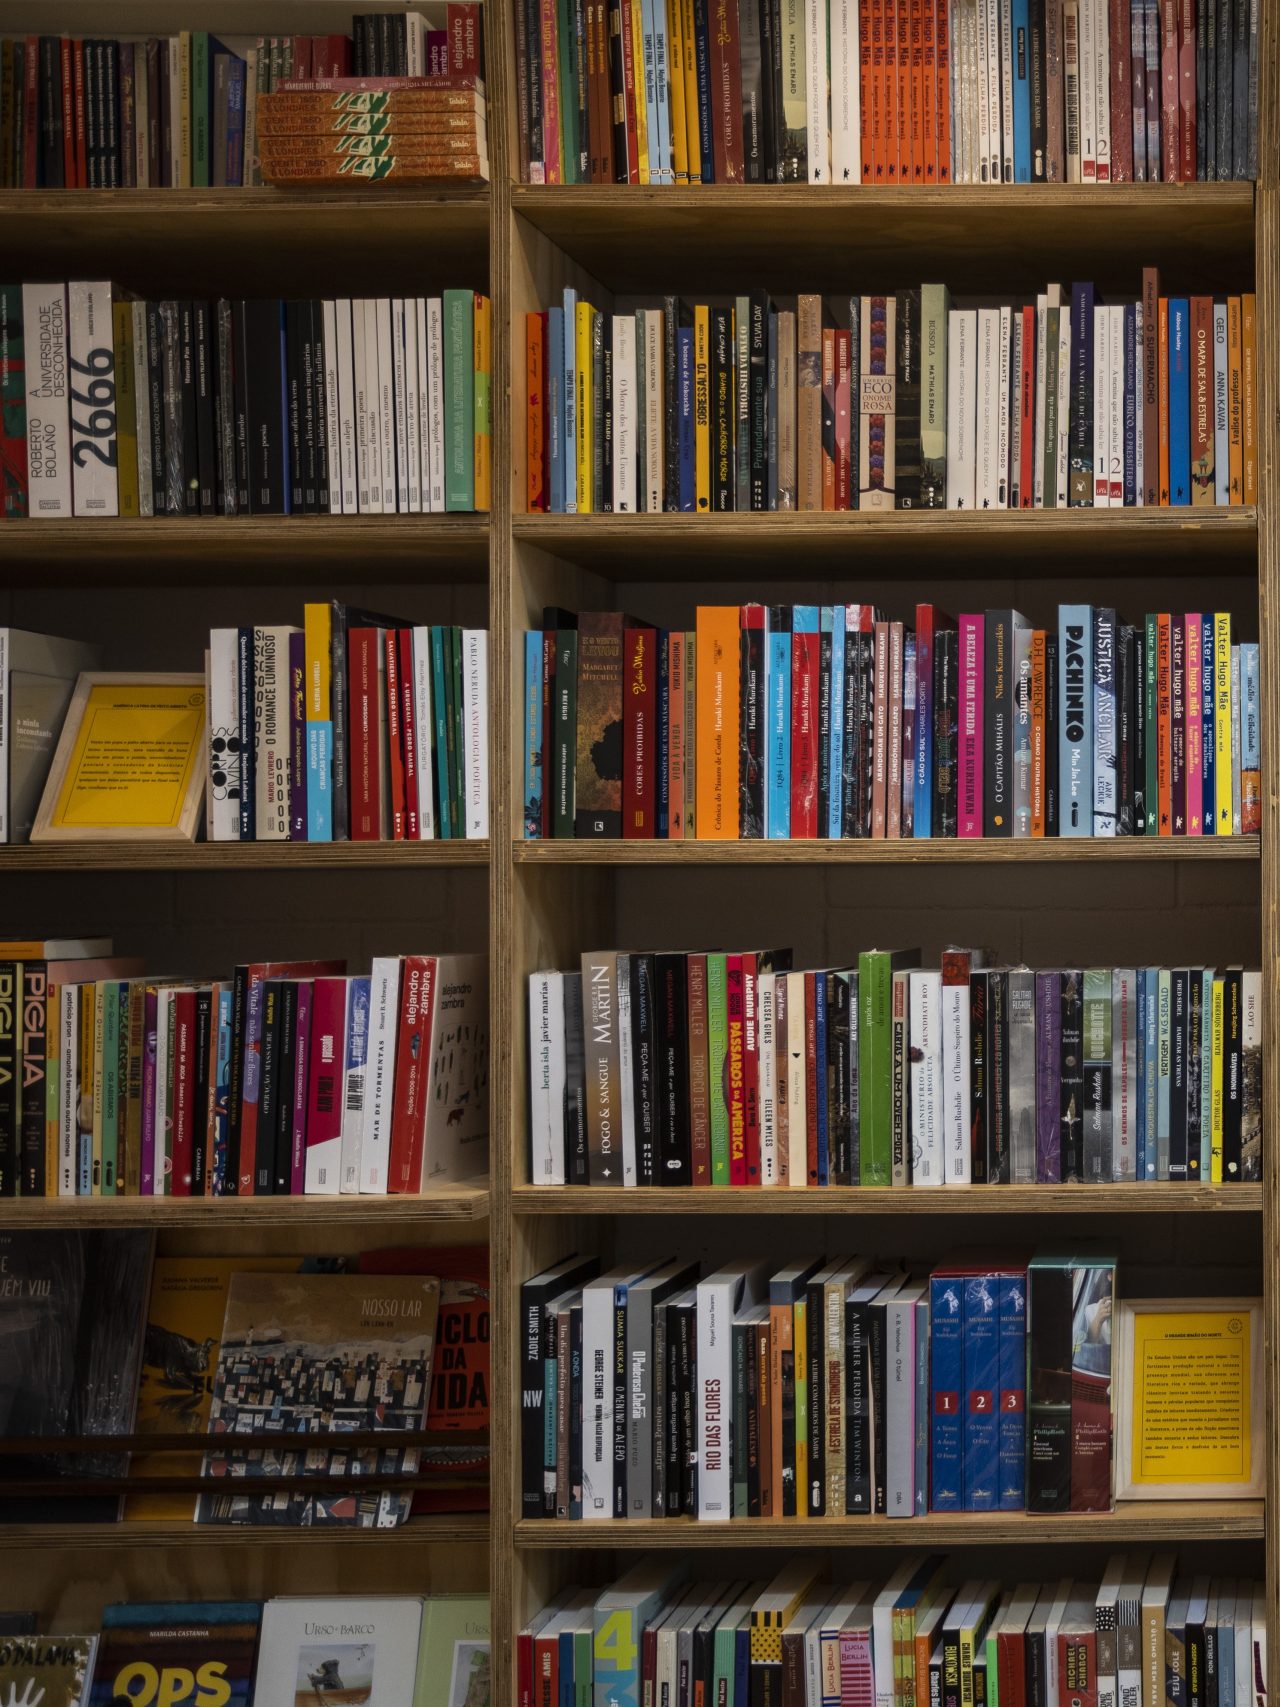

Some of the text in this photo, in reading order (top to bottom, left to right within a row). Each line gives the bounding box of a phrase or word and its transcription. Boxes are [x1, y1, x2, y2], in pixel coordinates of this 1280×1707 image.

[454, 18, 462, 70] alejandro
[466, 19, 474, 60] zambra
[698, 36, 706, 76] MÁSCARA
[702, 95, 707, 103] DE
[723, 63, 731, 113] PROIBIDAS
[701, 105, 709, 153] CONFISSÕES
[751, 147, 757, 157] Os
[41, 305, 53, 398] UNIVERSIDADE
[52, 299, 64, 397] DESCONHECIDA
[754, 306, 762, 348] SYLVIA DAY
[1216, 318, 1224, 343] GELO
[29, 388, 40, 398] A
[697, 364, 707, 425] SOBRESSALTO
[1147, 337, 1155, 404] SUPERMACHO
[1231, 370, 1240, 405] professor
[70, 348, 117, 468] 2666
[753, 396, 763, 469] Profundamente
[1217, 400, 1225, 430] KAVAN
[1231, 407, 1238, 415] do
[1231, 417, 1239, 436] valise
[30, 419, 43, 477] ROBERTO
[42, 424, 57, 477] BOLAÑO
[265, 635, 275, 684] LUMINOSO
[995, 624, 1003, 699] Nikos Kazantzákis
[1066, 626, 1083, 742] PACHINKO
[265, 688, 275, 735] ROMANCE
[714, 672, 722, 730] Haruki Murakami
[212, 727, 227, 800] CORPOS
[227, 727, 239, 799] DIVINOS
[406, 971, 420, 1024] alejandro
[419, 972, 430, 1014] zambra
[591, 965, 611, 1044] MARTIN
[745, 975, 754, 1051] AUDIE MURPHY
[23, 973, 45, 1087] PIGLIA
[540, 982, 550, 1089] berta isla javier marías
[376, 1040, 384, 1098] TORMENTAS
[374, 1103, 380, 1115] DE
[599, 1057, 611, 1154] FOGO & SANGUE
[954, 1092, 962, 1121] Rushdie
[362, 1299, 422, 1317] NOSSO LAR
[529, 1306, 539, 1360] ZADIE SMITH
[523, 1390, 542, 1407] NW
[977, 1396, 984, 1408] 2
[1008, 1396, 1016, 1407] 3
[706, 1380, 720, 1470] RIO DAS FLORES
[594, 1609, 637, 1669] 4
[842, 1652, 868, 1661] BERLIN
[1067, 1646, 1075, 1688] MICHAEL
[1079, 1647, 1087, 1686] CHABON
[1171, 1651, 1180, 1696] TEJU COLE
